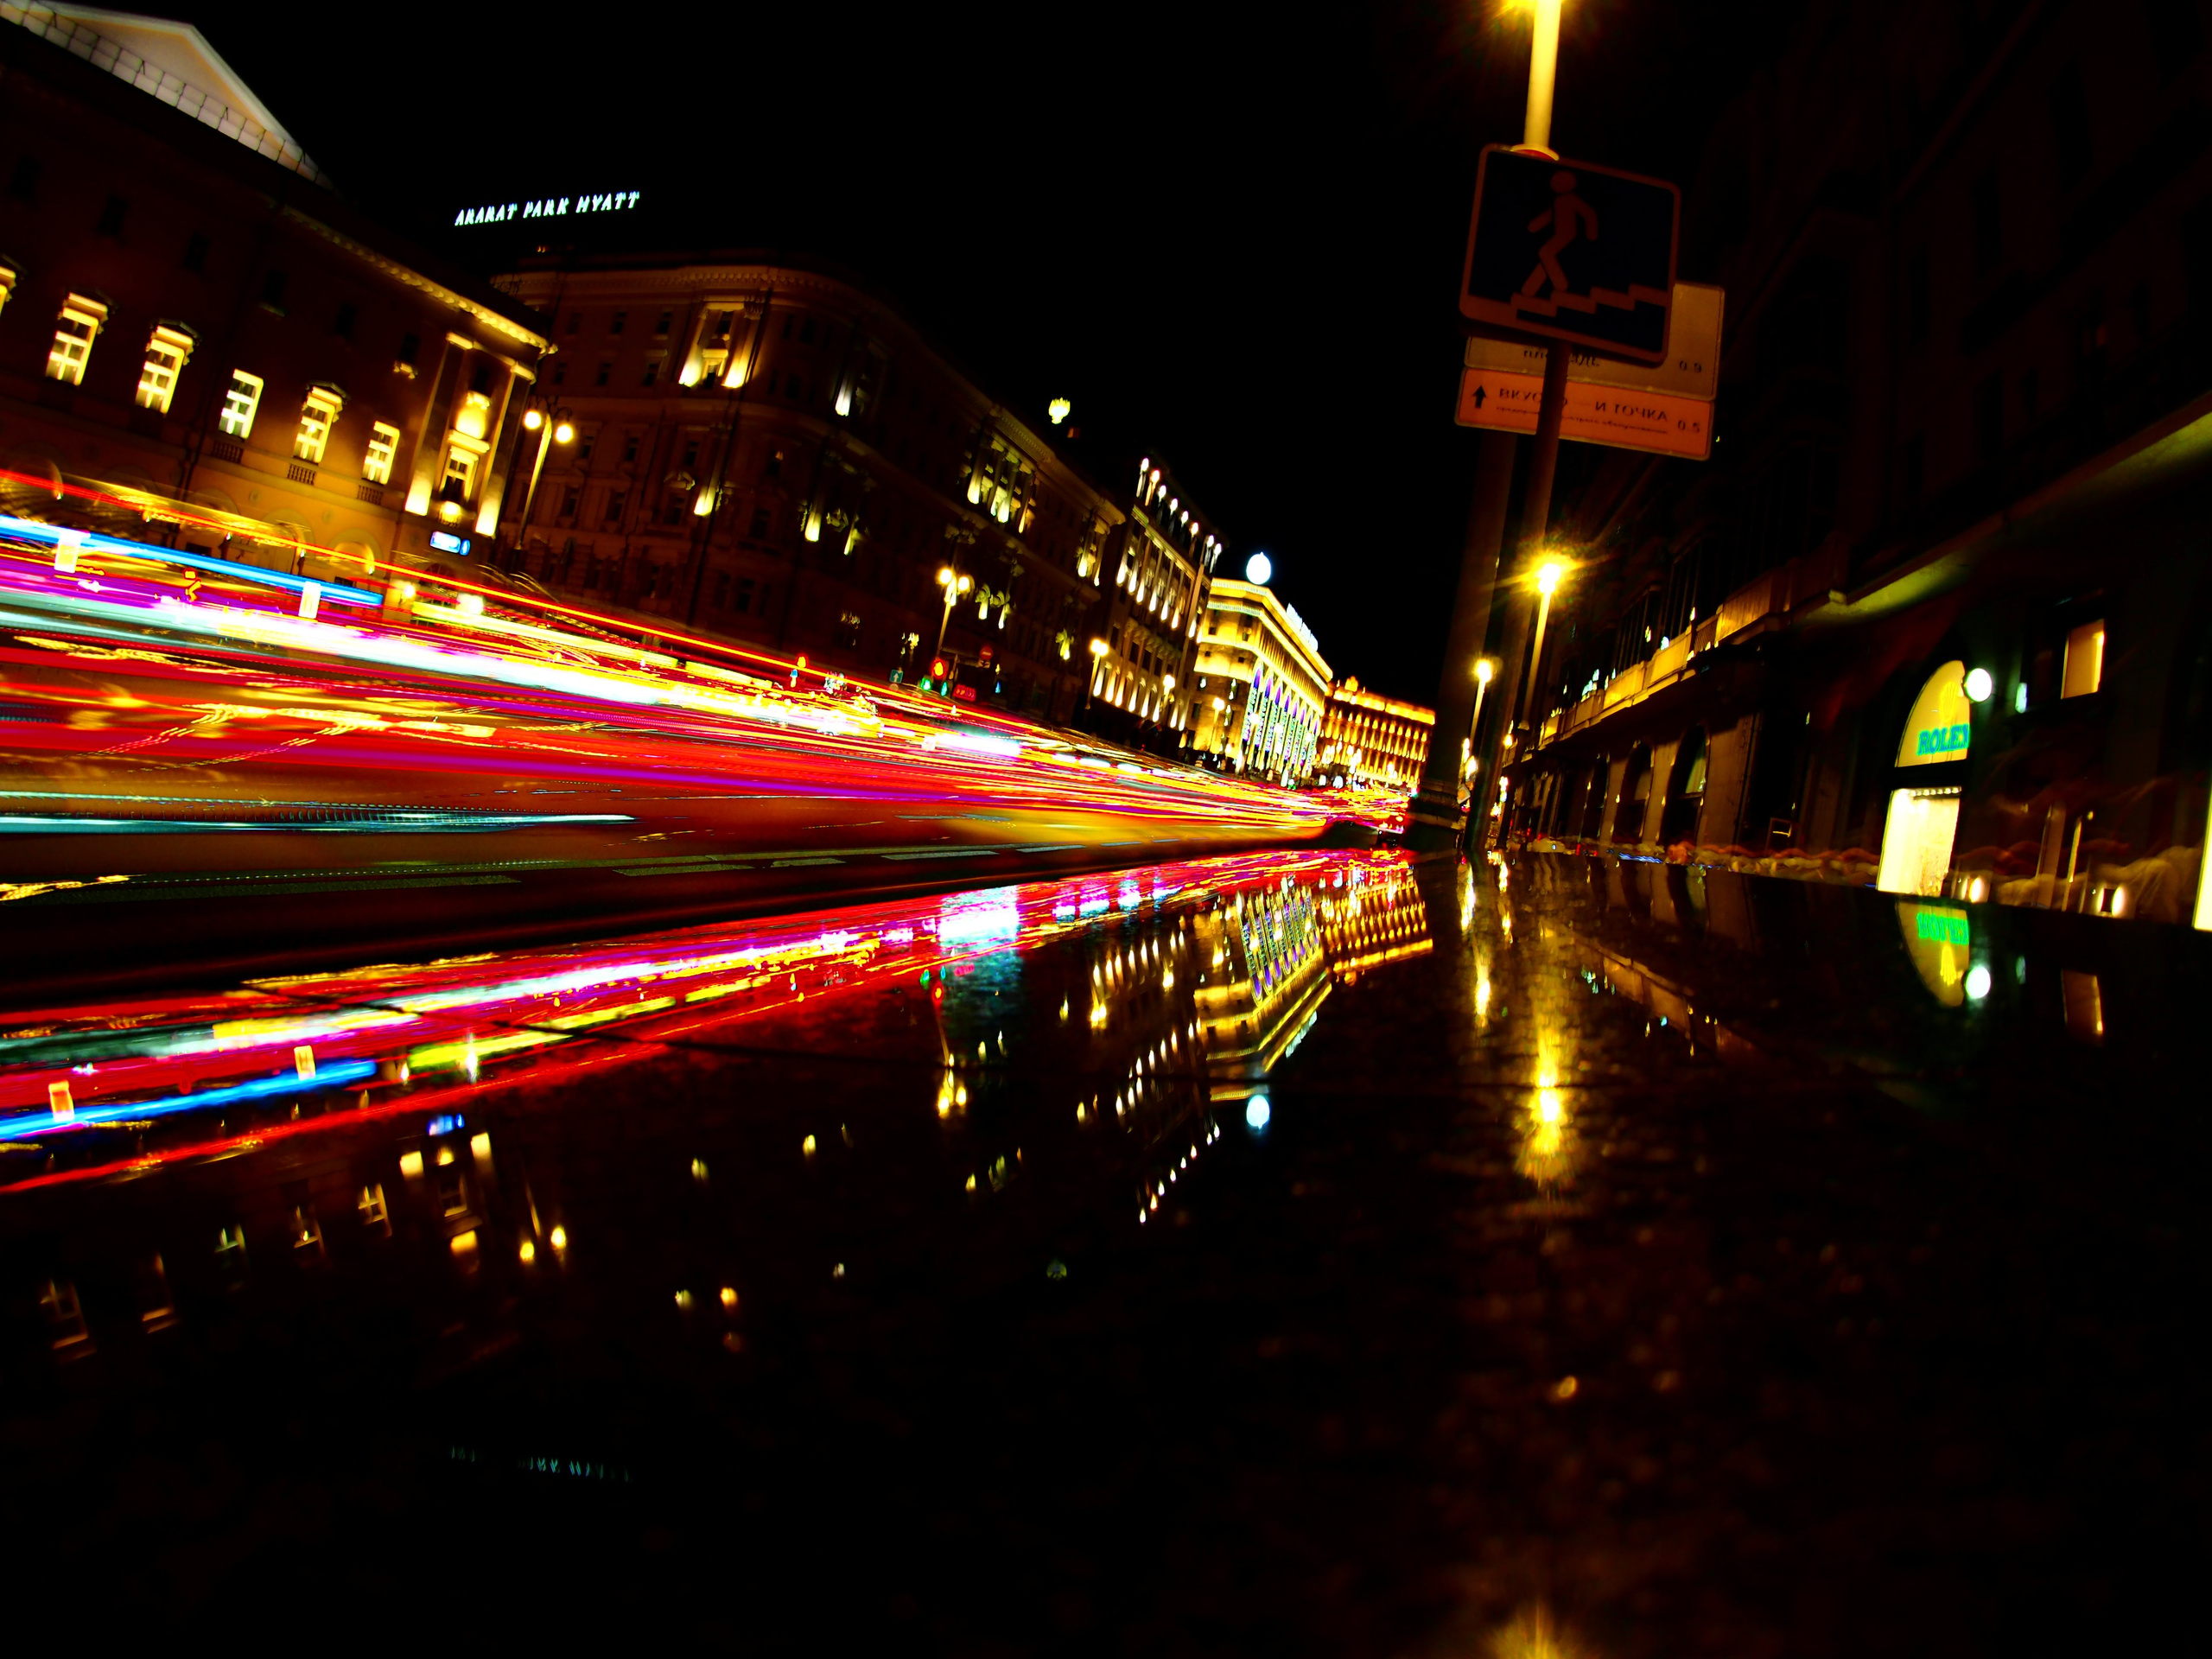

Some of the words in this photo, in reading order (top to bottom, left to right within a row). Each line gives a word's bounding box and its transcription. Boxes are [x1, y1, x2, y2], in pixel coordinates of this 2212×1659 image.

[454, 202, 518, 226] ARARAT
[522, 196, 570, 219] PARK
[575, 190, 640, 213] HYATT
[1613, 404, 1669, 423] ТОЧКА
